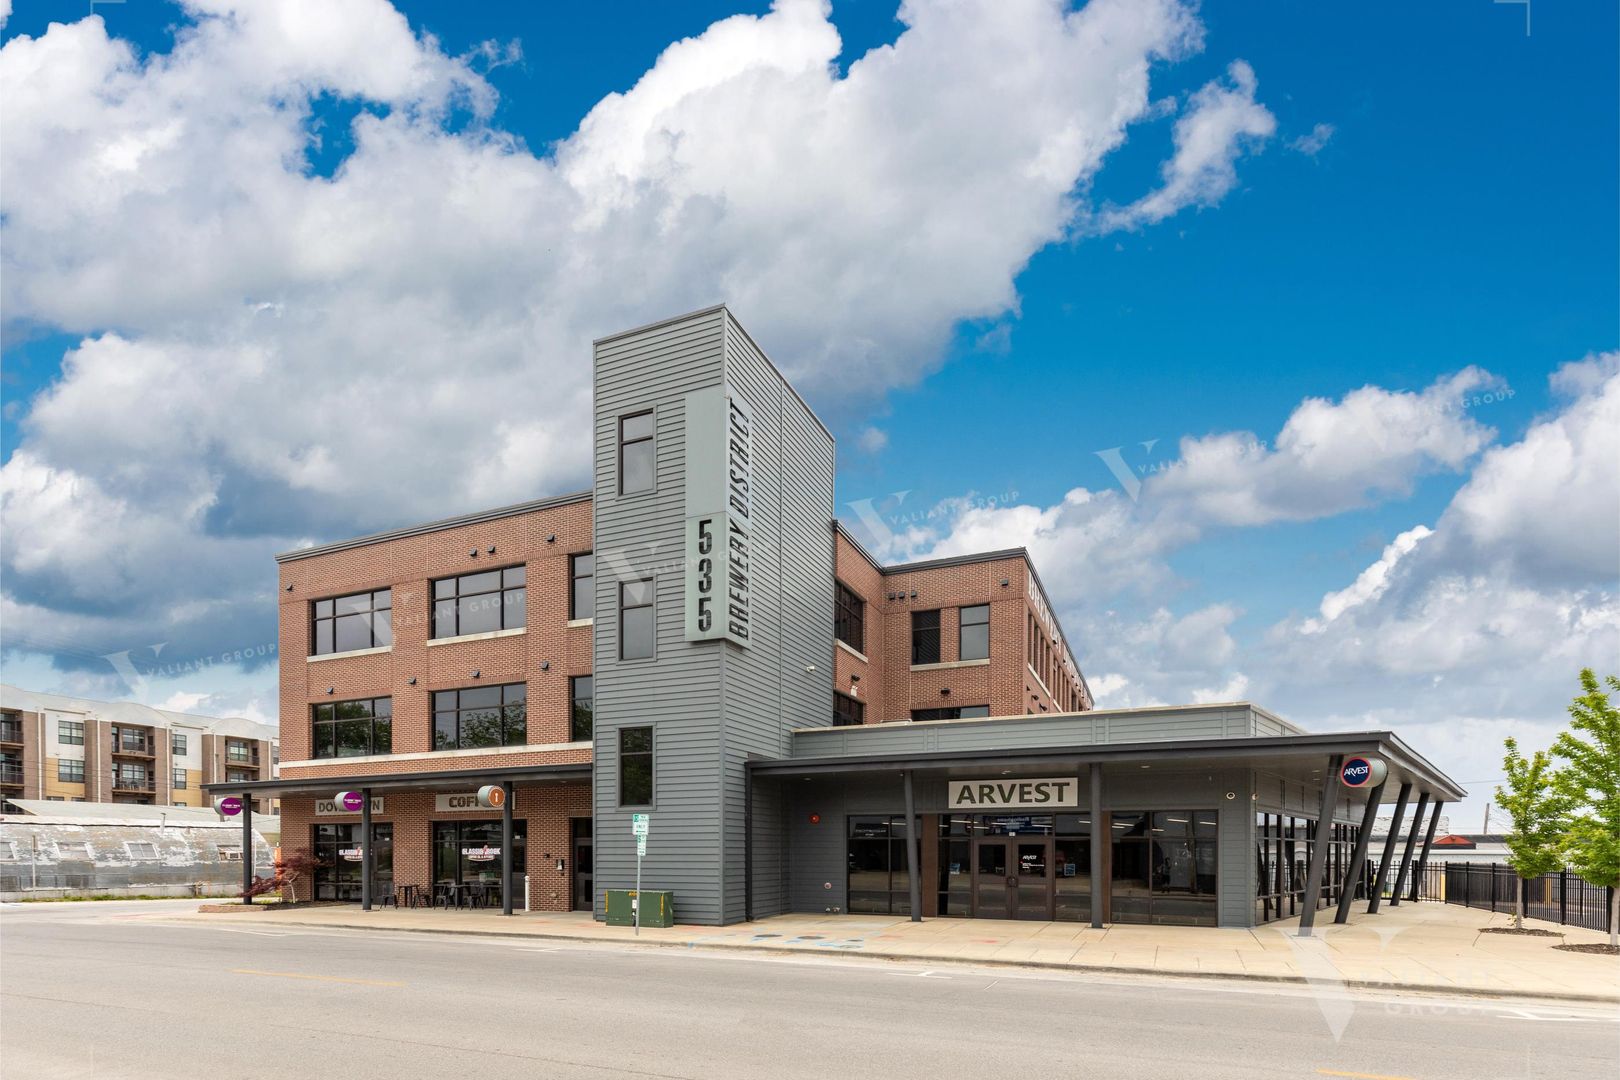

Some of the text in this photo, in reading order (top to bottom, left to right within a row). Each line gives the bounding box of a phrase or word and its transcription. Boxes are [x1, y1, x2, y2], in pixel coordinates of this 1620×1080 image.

[729, 397, 749, 641] BREWERY DISTRICT
[698, 518, 712, 632] 535
[956, 781, 1070, 805] ARVEST
[1344, 765, 1369, 777] ARVEST
